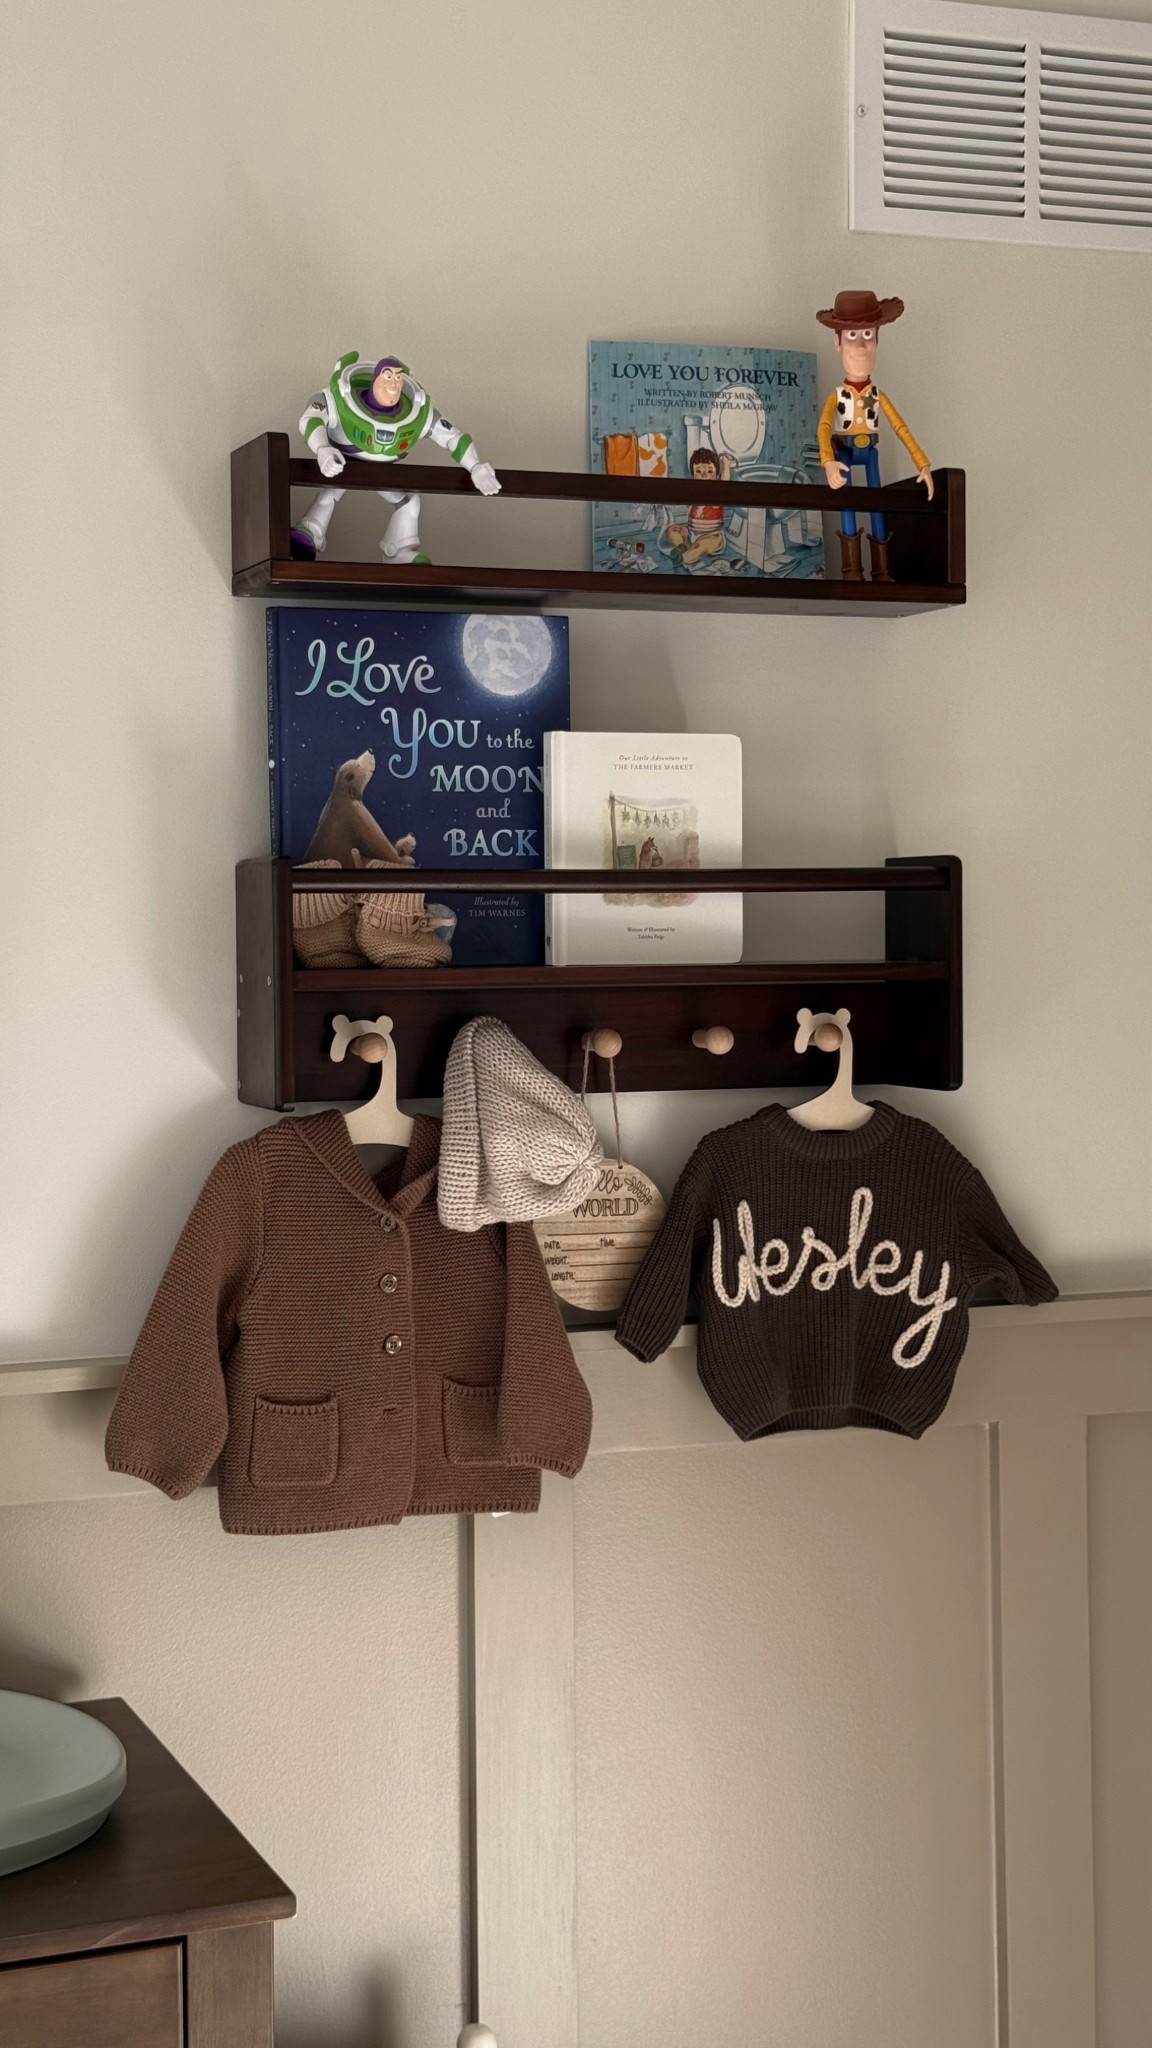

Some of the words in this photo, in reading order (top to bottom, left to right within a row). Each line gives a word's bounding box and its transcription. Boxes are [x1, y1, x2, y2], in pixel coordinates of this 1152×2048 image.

[611, 363, 663, 380] LOVE
[668, 364, 709, 382] YOU
[715, 366, 800, 387] FOREVER
[637, 398, 697, 408] ILLUSTRATED
[699, 400, 709, 409] BY
[711, 401, 741, 410] SHEILA
[742, 402, 779, 412] McGRAW
[643, 388, 686, 398] WRITTEN
[686, 389, 698, 398] BY
[700, 390, 733, 400] ROBERT
[734, 392, 772, 402] MUNSCH
[295, 638, 327, 697] I
[486, 733, 504, 749] to
[506, 728, 535, 750] the
[430, 764, 545, 793] MOON
[476, 798, 511, 819] and
[443, 828, 540, 857] BACK
[469, 909, 486, 917] TIM
[489, 909, 526, 917] WARNES
[474, 896, 510, 906] Illustrated
[510, 896, 520, 908] by
[573, 1197, 639, 1219] WORLD
[712, 1186, 958, 1369] Wesley
